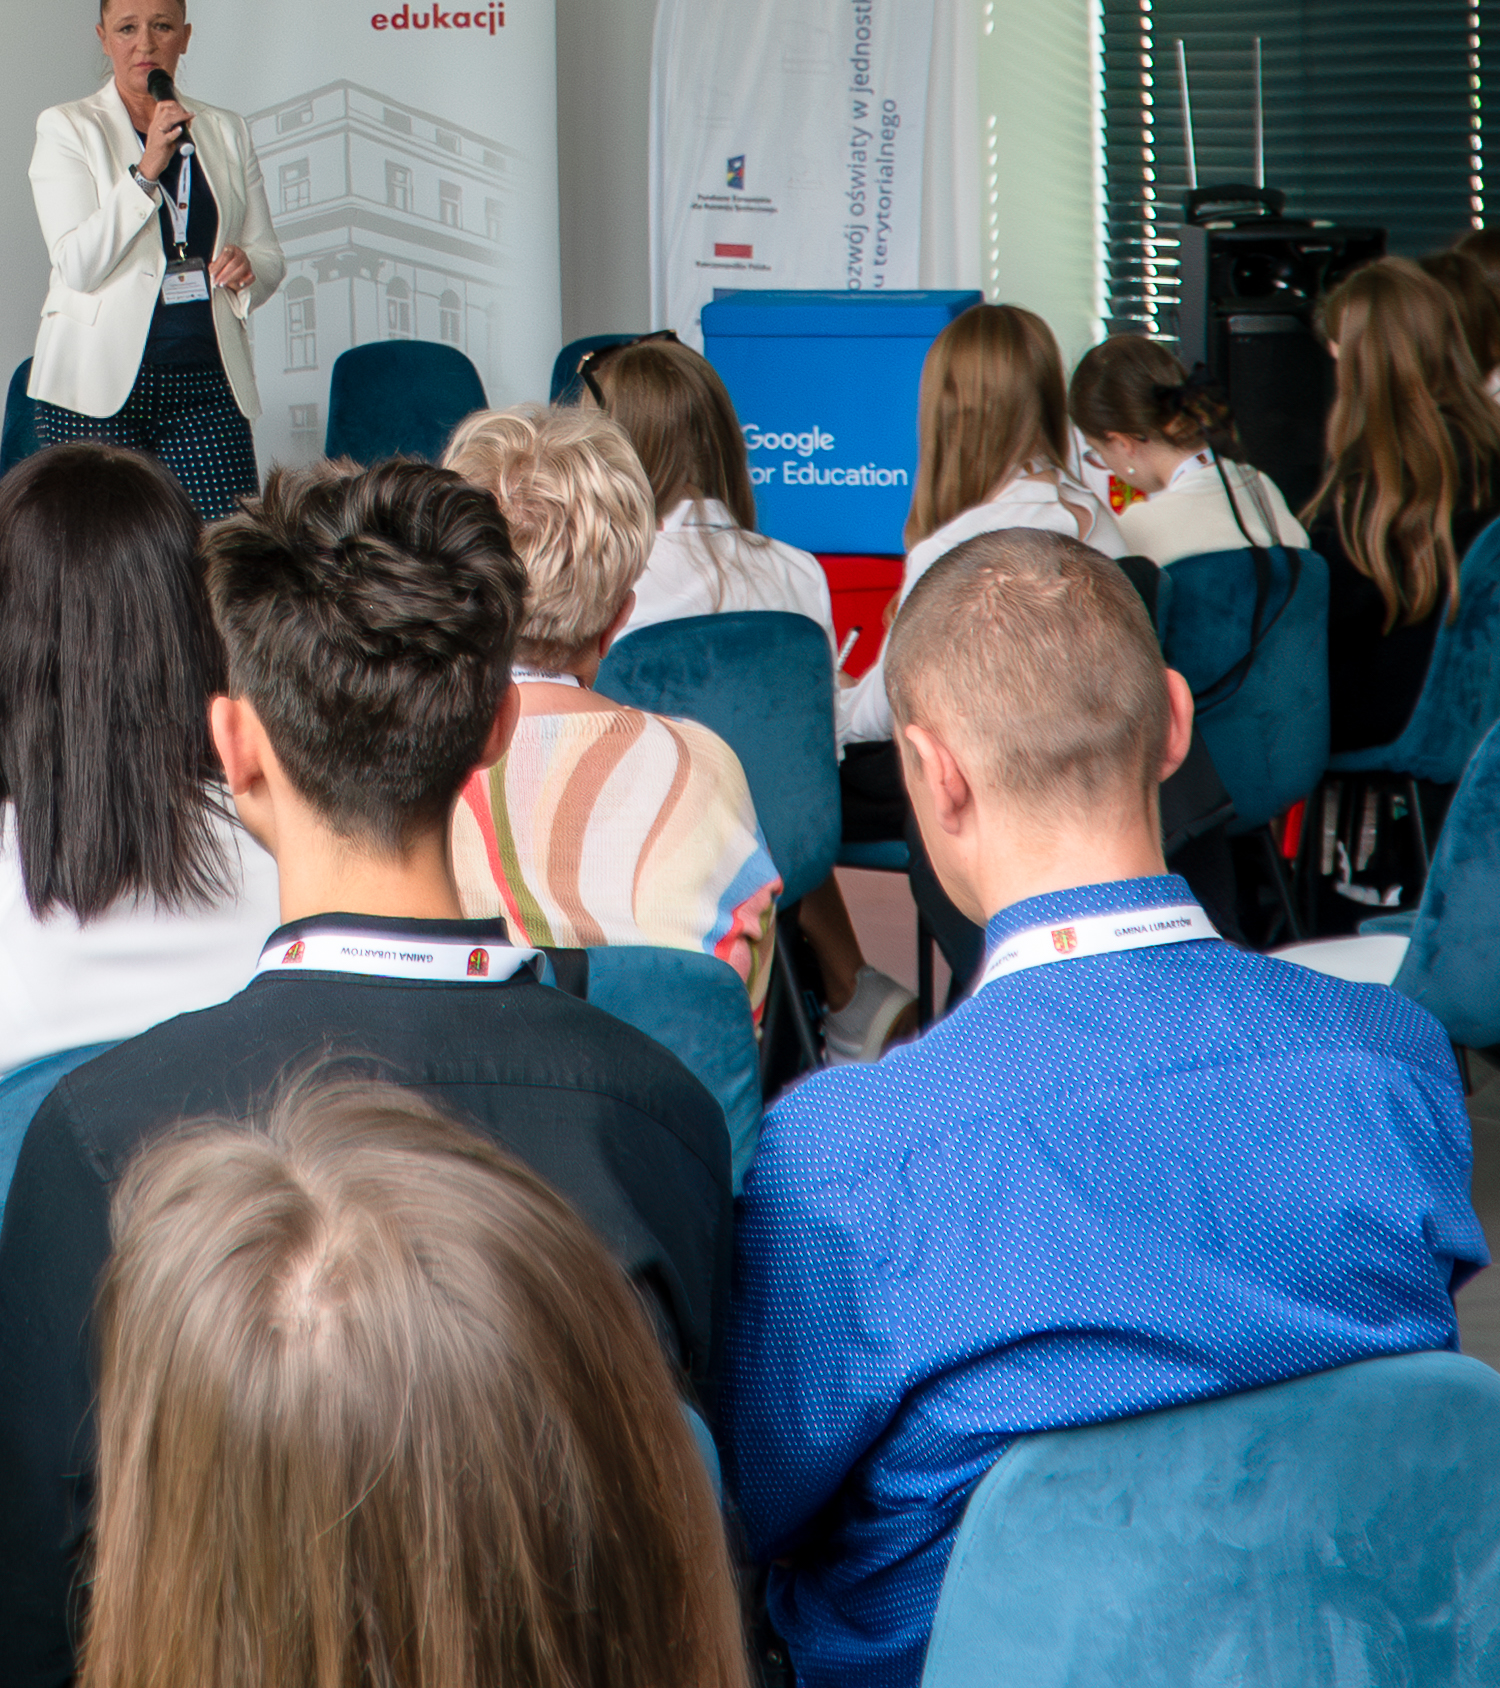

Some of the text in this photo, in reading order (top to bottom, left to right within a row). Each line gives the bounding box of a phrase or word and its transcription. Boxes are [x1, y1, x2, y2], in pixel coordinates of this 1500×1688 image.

[370, 1, 505, 36] edukacji
[853, 99, 869, 120] w
[845, 126, 873, 217] oświaty
[873, 99, 901, 267] terytorialnego
[844, 224, 870, 290] ozwój
[742, 423, 835, 457] Google
[750, 461, 908, 487] or Education
[1114, 917, 1193, 937] GMINA LUBARTÓW
[340, 947, 434, 963] GMINA LUBARTÓW
